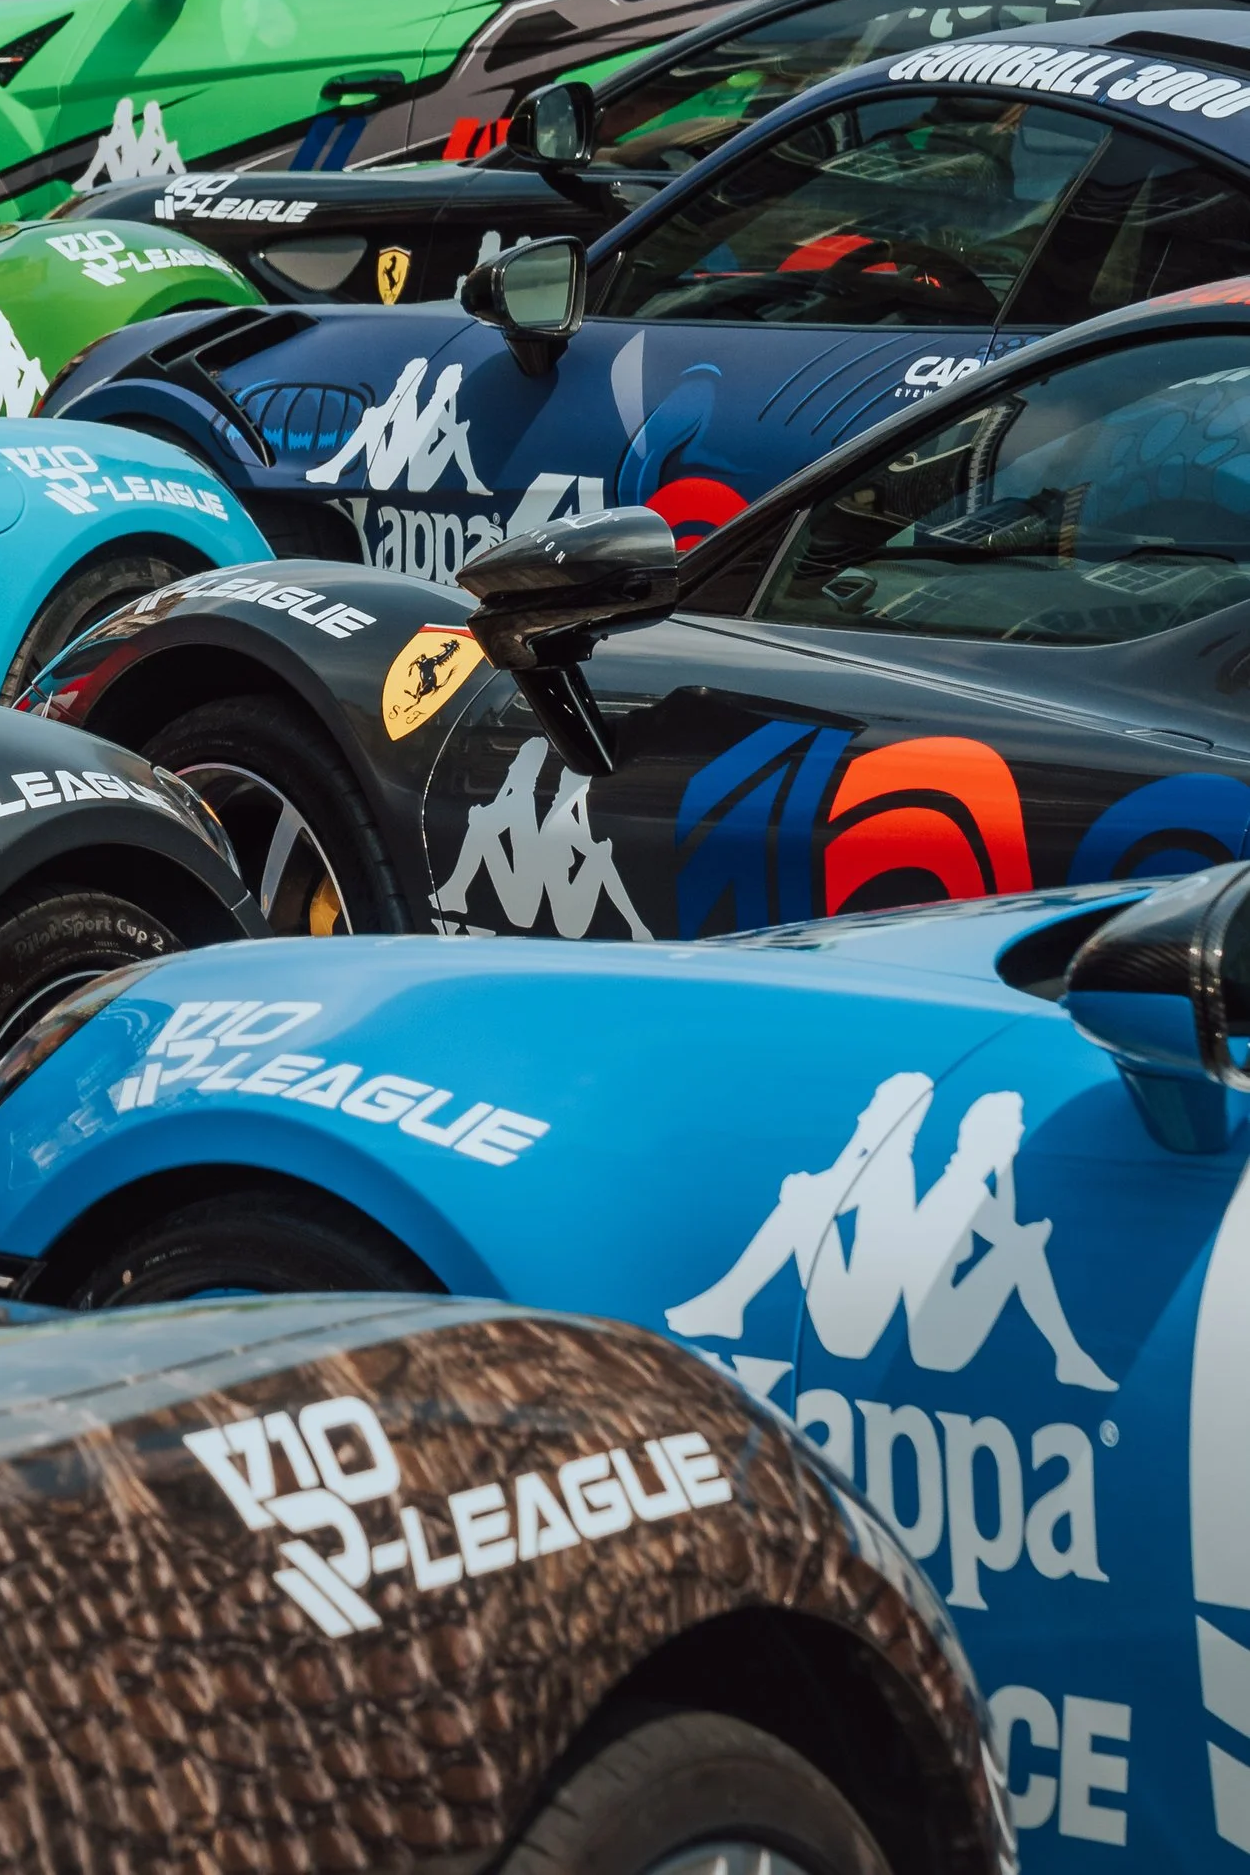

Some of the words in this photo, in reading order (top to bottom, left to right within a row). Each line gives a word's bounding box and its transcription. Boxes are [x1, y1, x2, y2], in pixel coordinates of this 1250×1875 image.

[888, 44, 1134, 96] GUMBALL
[1107, 64, 1250, 119] 3000
[904, 355, 991, 387] CAR
[13, 915, 58, 957] Pilot
[61, 911, 112, 938] Sport
[116, 918, 149, 944] Cup
[151, 932, 165, 953] 2
[117, 1037, 551, 1168] R-LEAGUE
[263, 1431, 734, 1640] R-LEAGUE
